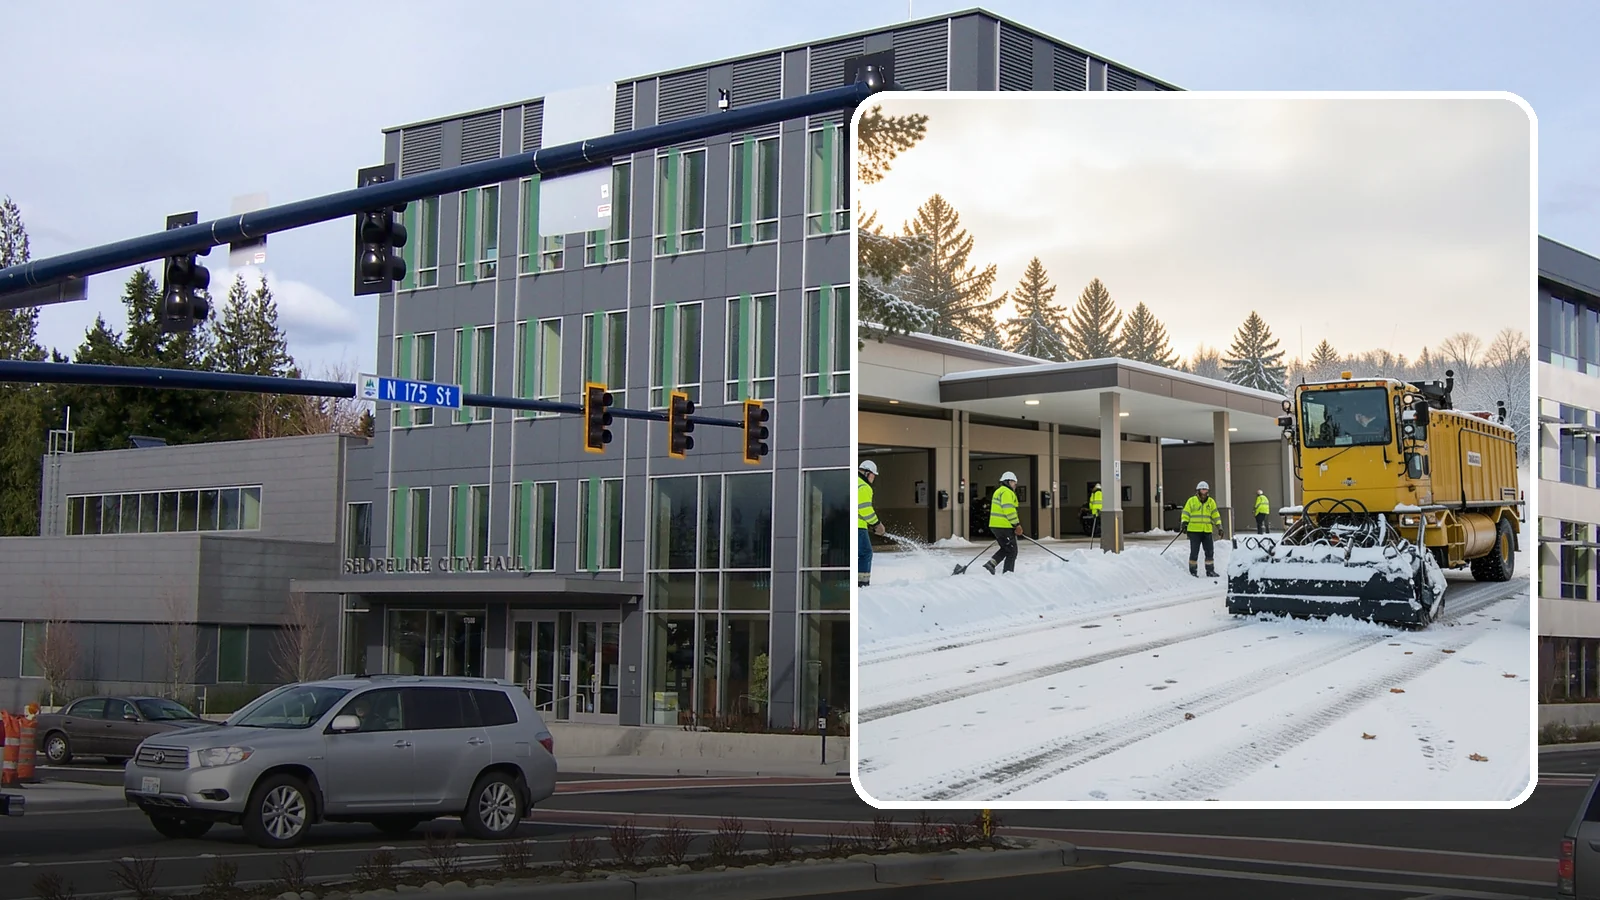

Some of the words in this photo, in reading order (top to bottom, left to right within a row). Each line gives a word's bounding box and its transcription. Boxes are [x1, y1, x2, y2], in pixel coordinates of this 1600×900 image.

[387, 380, 396, 399] N
[405, 383, 427, 403] 175
[436, 386, 451, 406] St
[344, 557, 432, 574] SHORELINE
[438, 557, 475, 572] CITY
[484, 556, 525, 571] HALL
